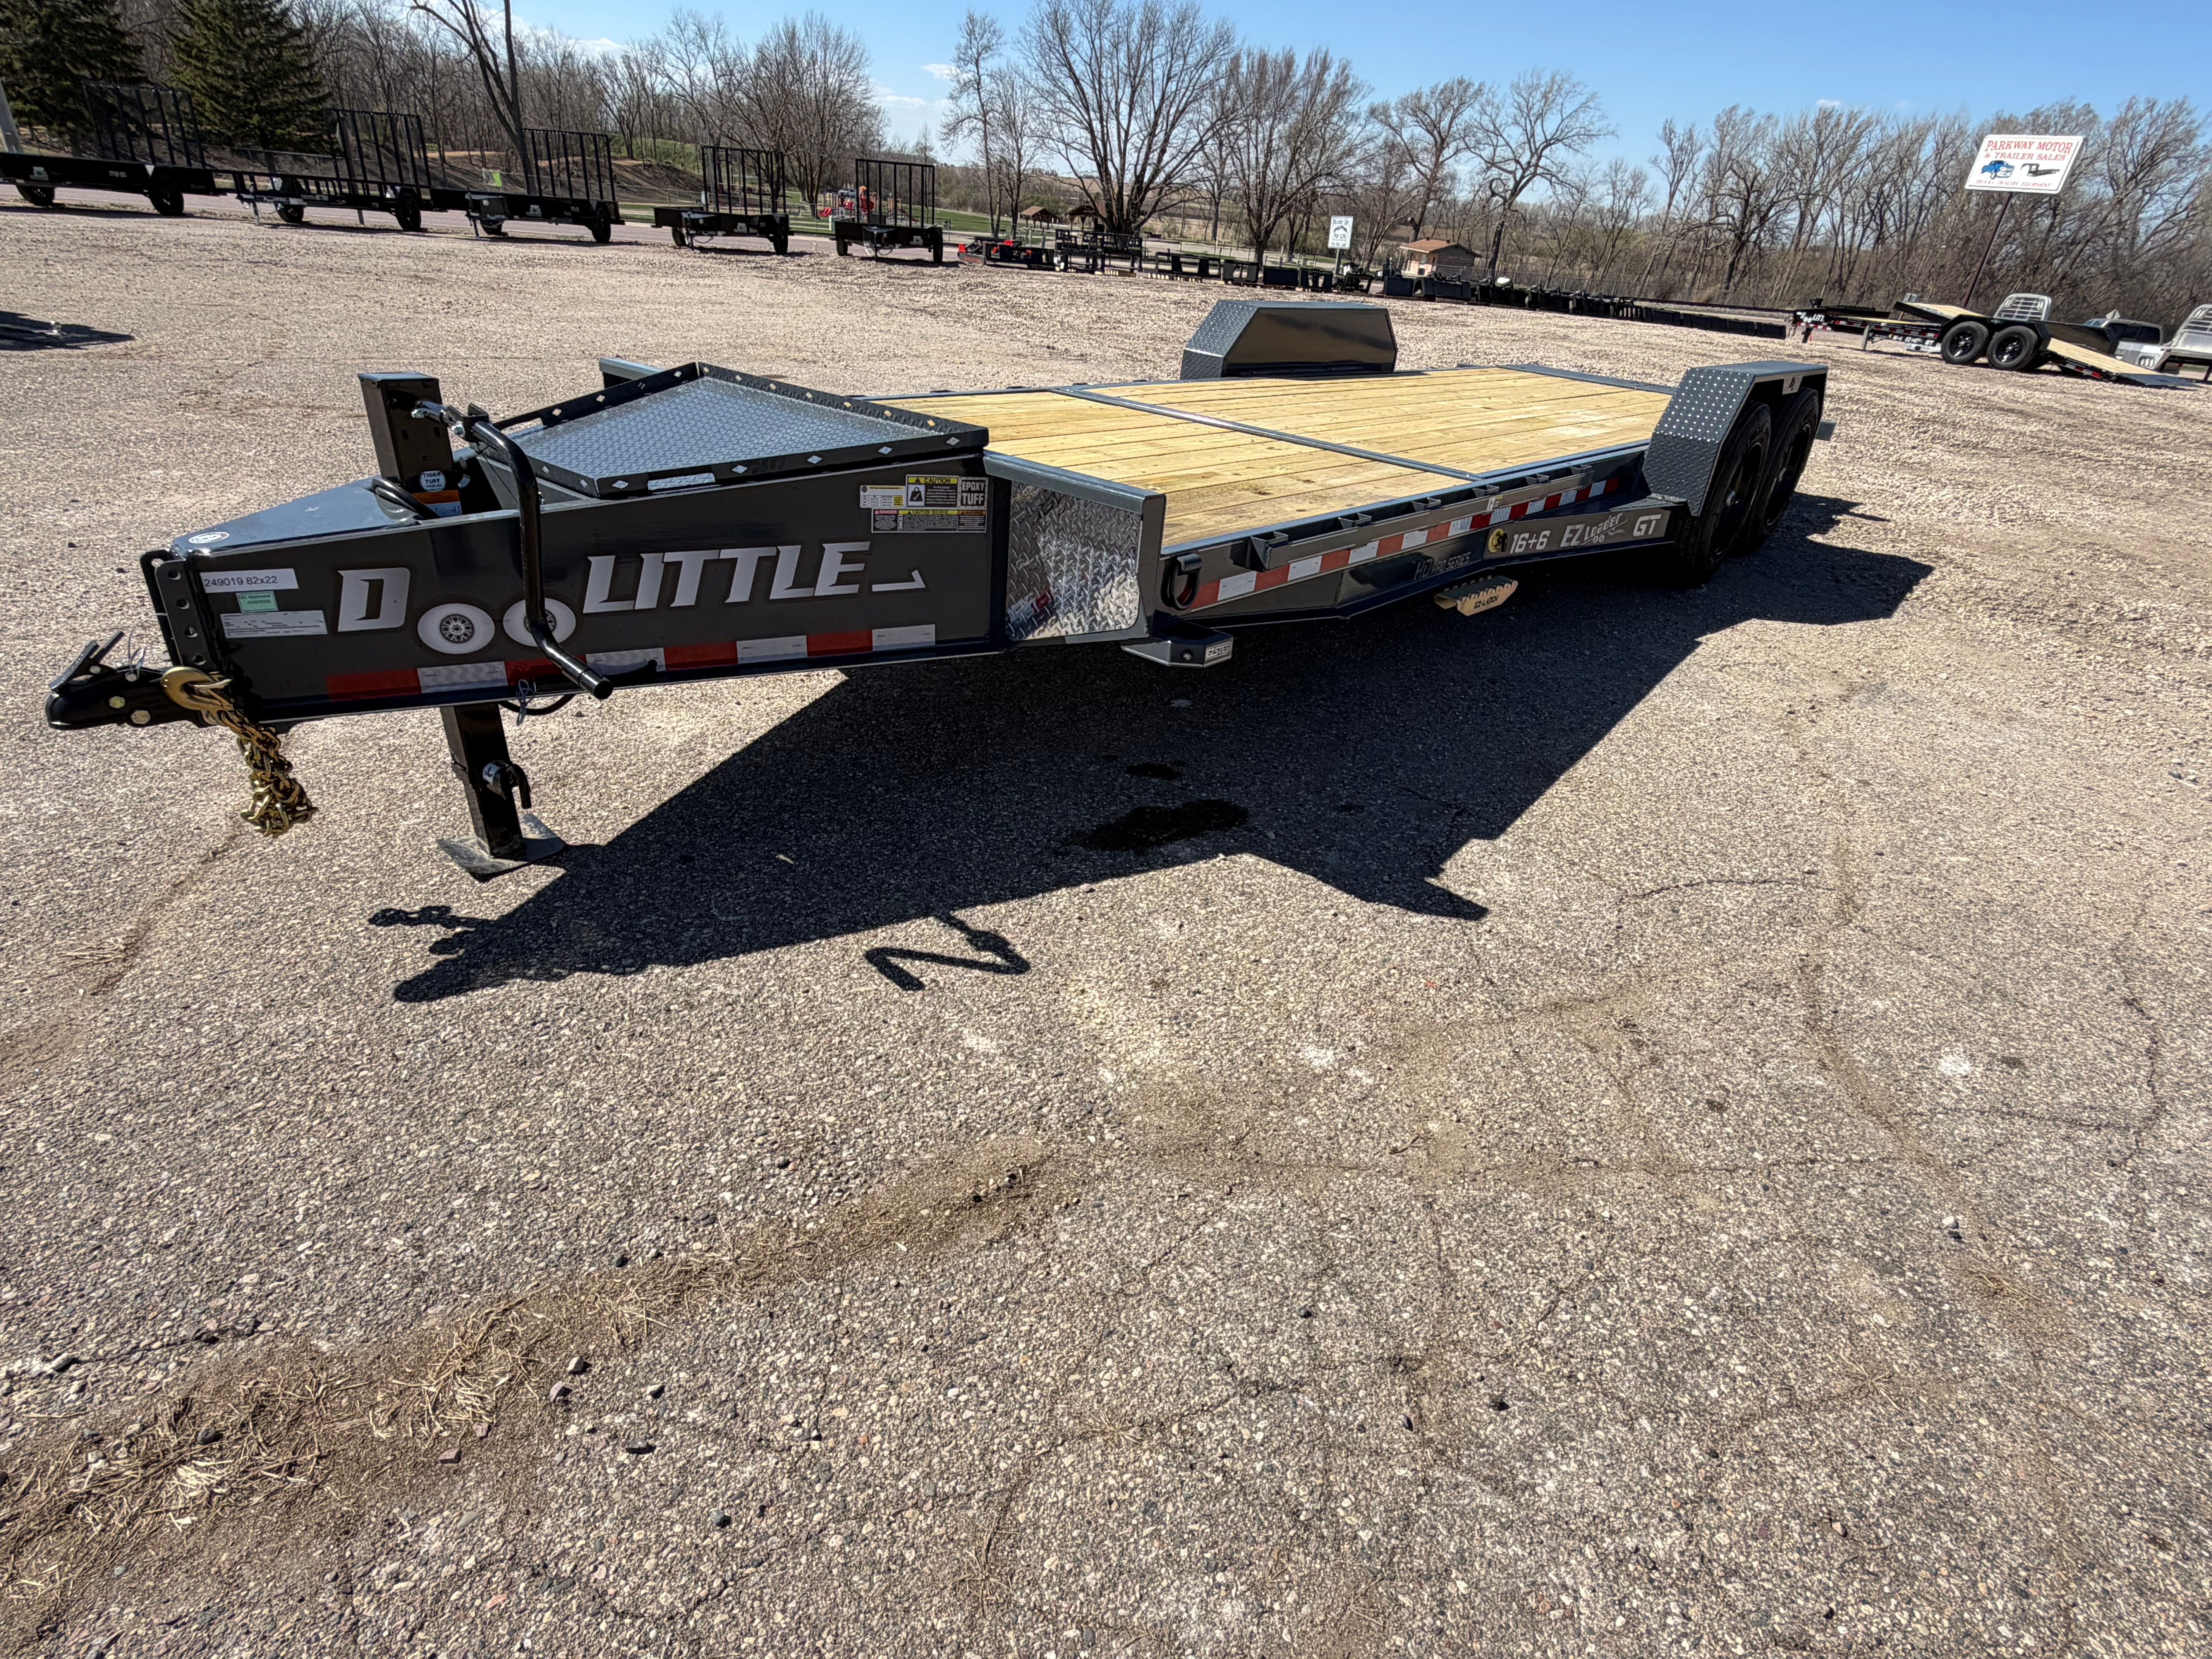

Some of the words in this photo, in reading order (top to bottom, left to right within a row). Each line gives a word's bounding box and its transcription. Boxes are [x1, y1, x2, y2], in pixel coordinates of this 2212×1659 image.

[1985, 141, 2035, 151] PARKWAY
[2036, 142, 2073, 154] MOTOR
[962, 481, 985, 491] EPOXY
[962, 493, 984, 505] TUFF
[1510, 531, 1550, 554] 16+6
[1560, 524, 1585, 548] EZ
[1584, 512, 1623, 541] Loader
[1633, 514, 1662, 536] GT
[1414, 558, 1432, 581] HD
[204, 577, 244, 587] 249019
[246, 575, 278, 585] 82x22
